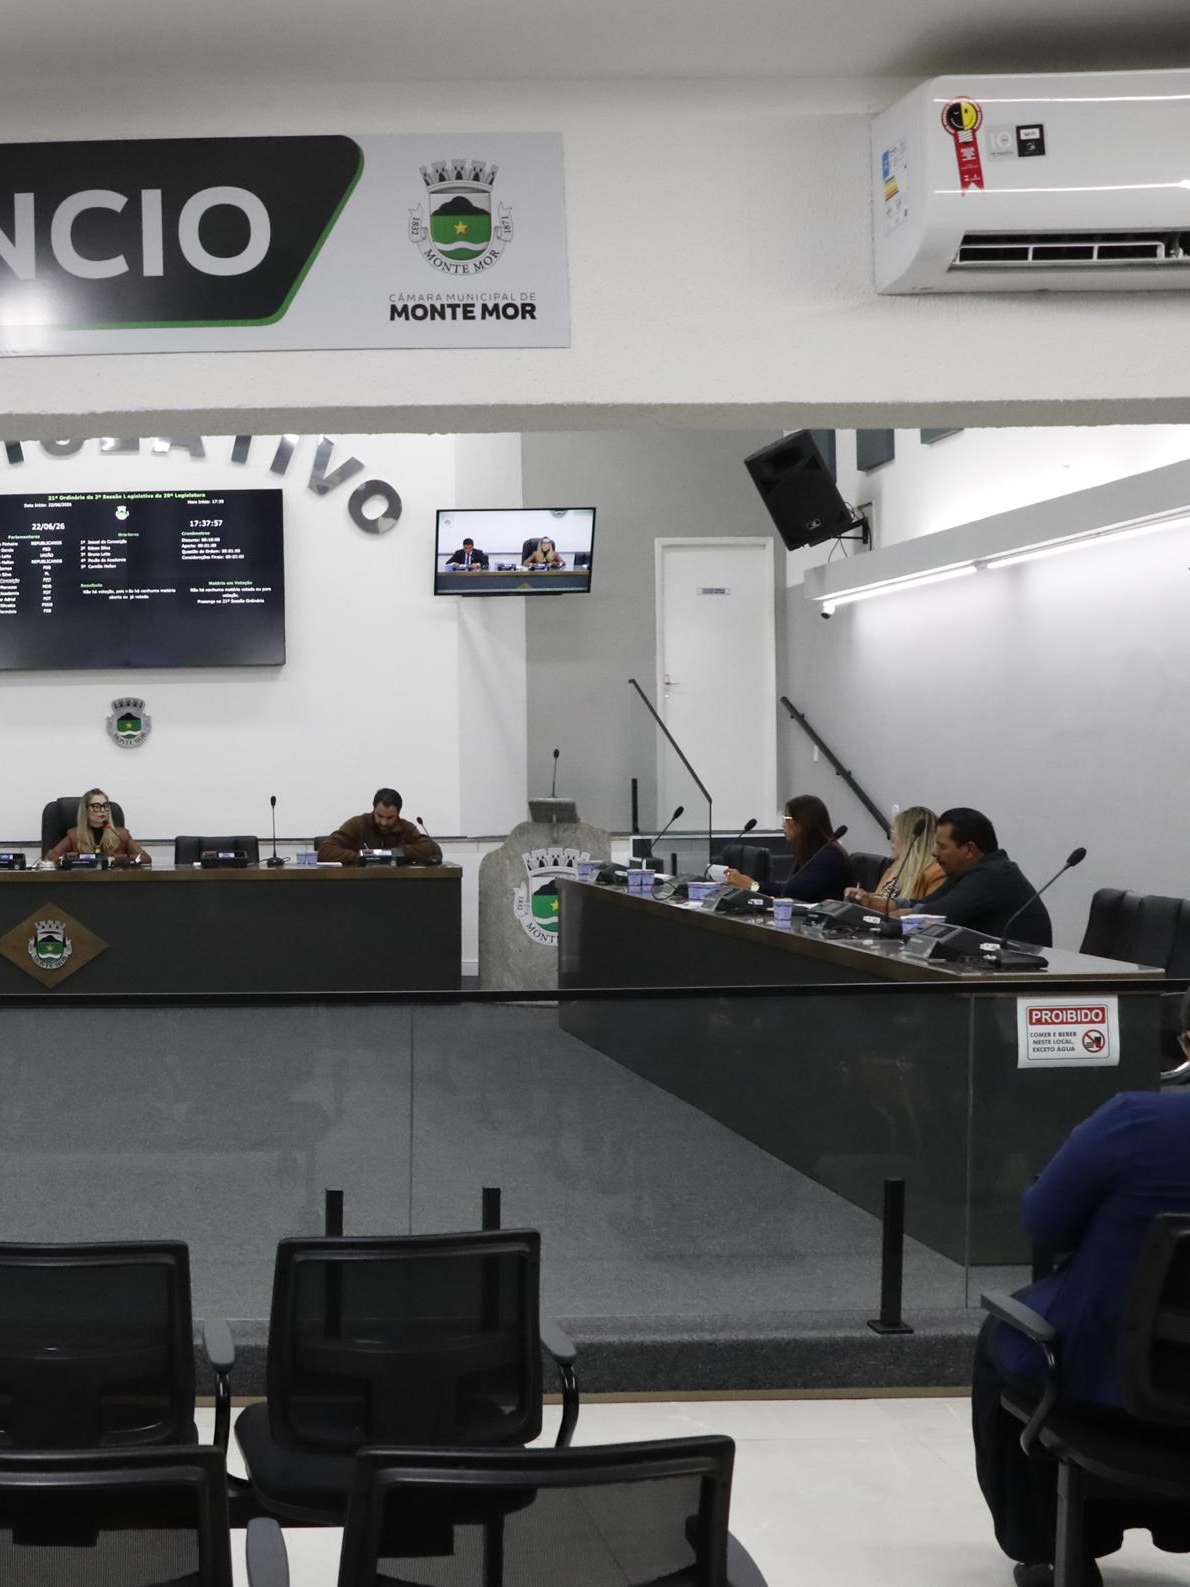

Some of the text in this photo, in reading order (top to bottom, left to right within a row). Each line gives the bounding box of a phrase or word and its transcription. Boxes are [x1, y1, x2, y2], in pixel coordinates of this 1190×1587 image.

[411, 217, 420, 235] 1832
[502, 216, 512, 233] 1871
[424, 249, 500, 274] MONTE MOR
[389, 291, 536, 302] CÂMARA MUNICIPAL DE
[390, 302, 537, 321] MONTE MOR
[32, 523, 65, 531] 22/06/26
[526, 922, 560, 943] MONT
[1032, 1009, 1103, 1023] PROIBIDO
